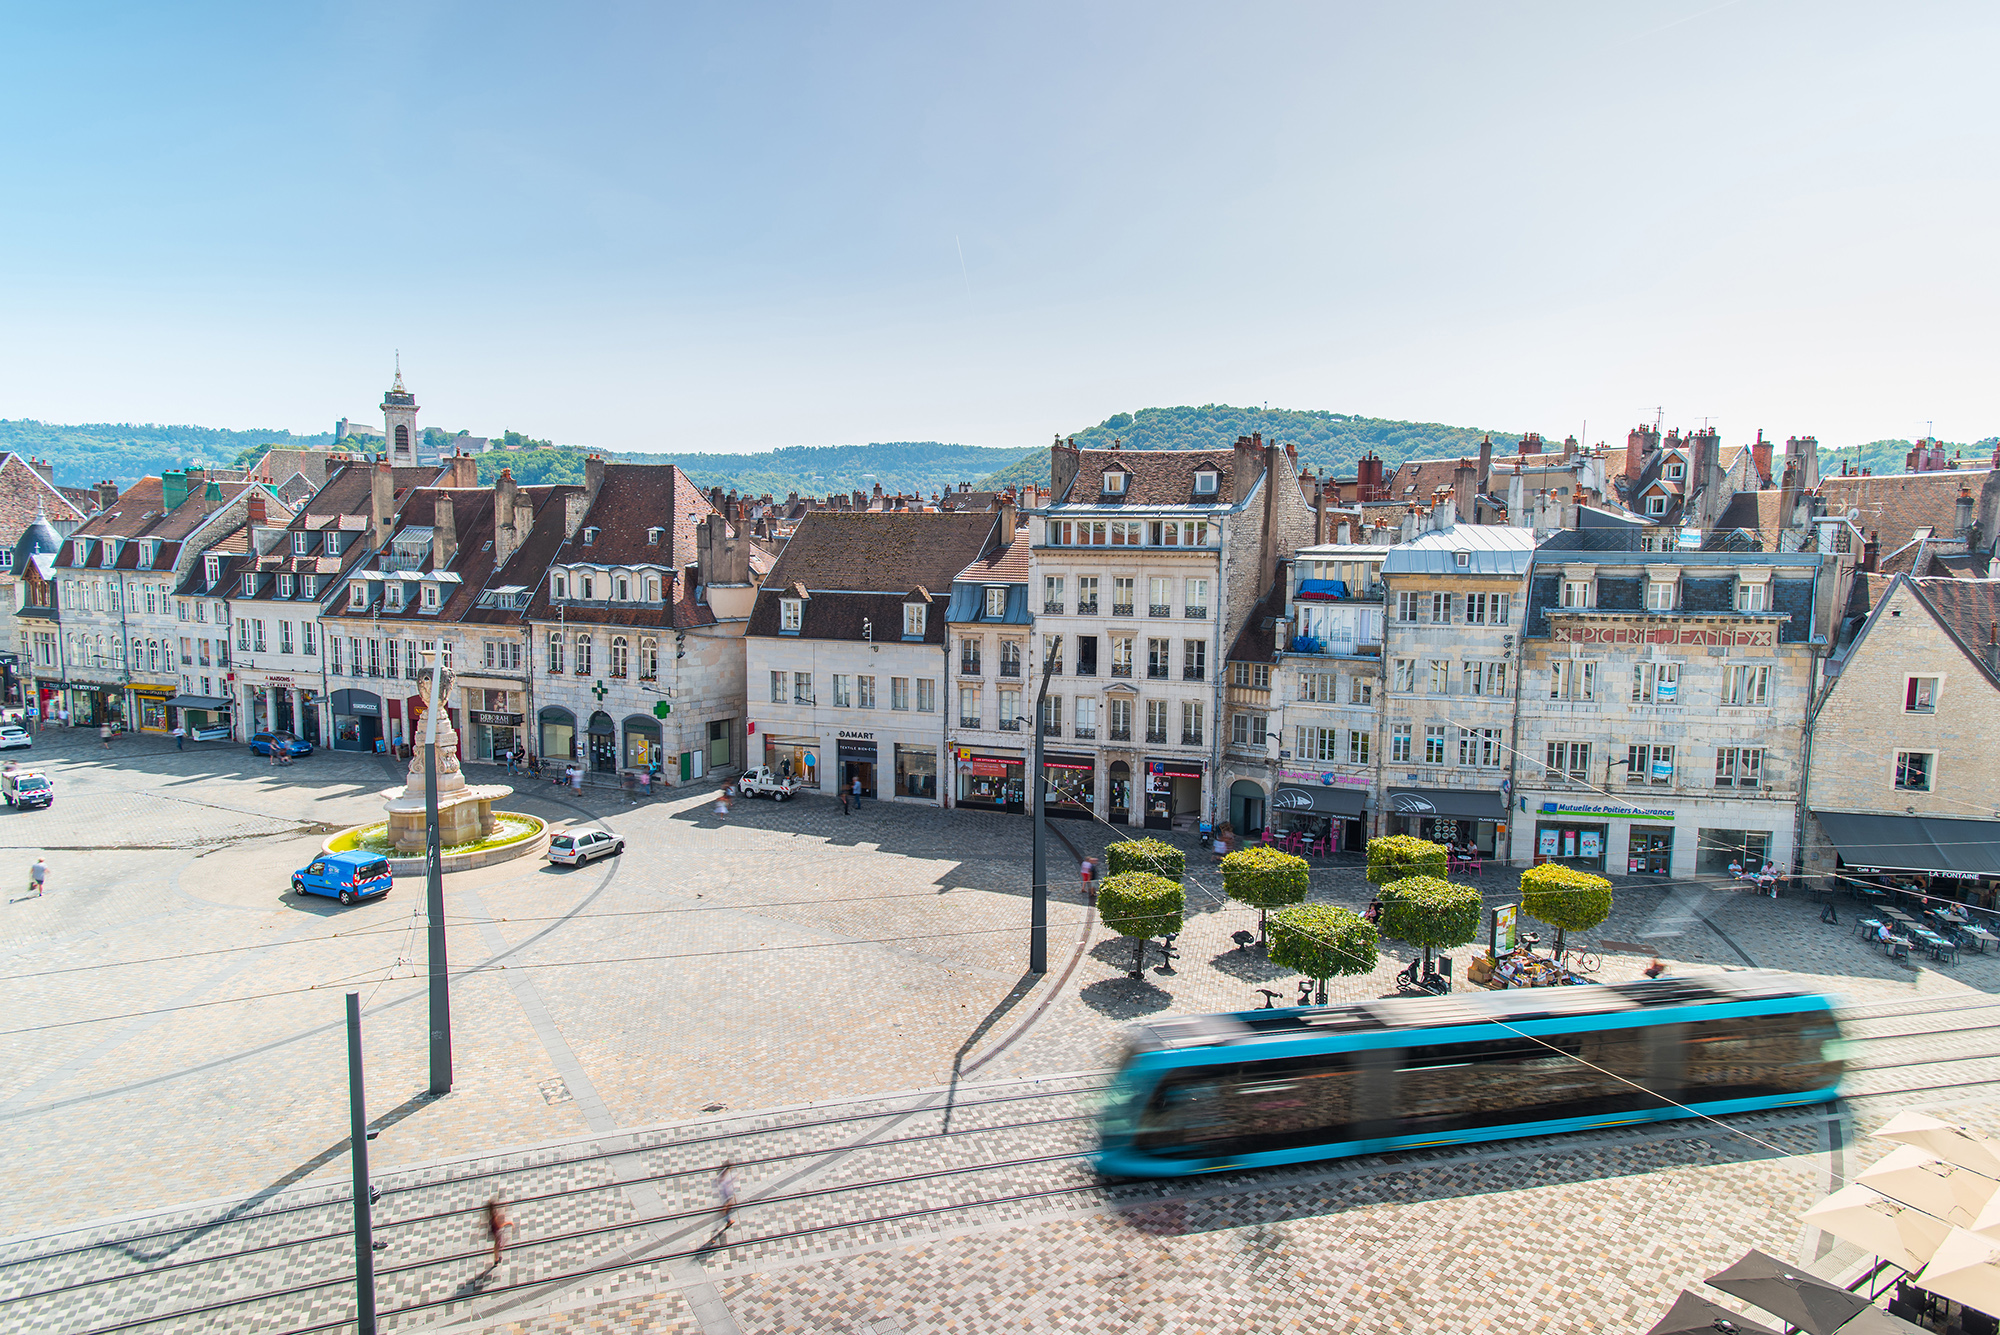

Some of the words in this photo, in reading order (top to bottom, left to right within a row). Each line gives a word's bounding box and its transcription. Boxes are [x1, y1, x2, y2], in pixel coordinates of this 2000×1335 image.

[1664, 628, 1758, 646] JEANNEY
[480, 713, 509, 721] DEBORAH
[839, 731, 874, 739] DAMART
[1279, 770, 1318, 780] PLANET
[1337, 776, 1370, 785] SUSHI
[1558, 803, 1592, 813] Mutuelle
[1592, 805, 1602, 813] de
[1602, 806, 1631, 814] Poitiers
[1632, 808, 1675, 816] Assurances
[1941, 872, 1980, 880] FONTAINE
